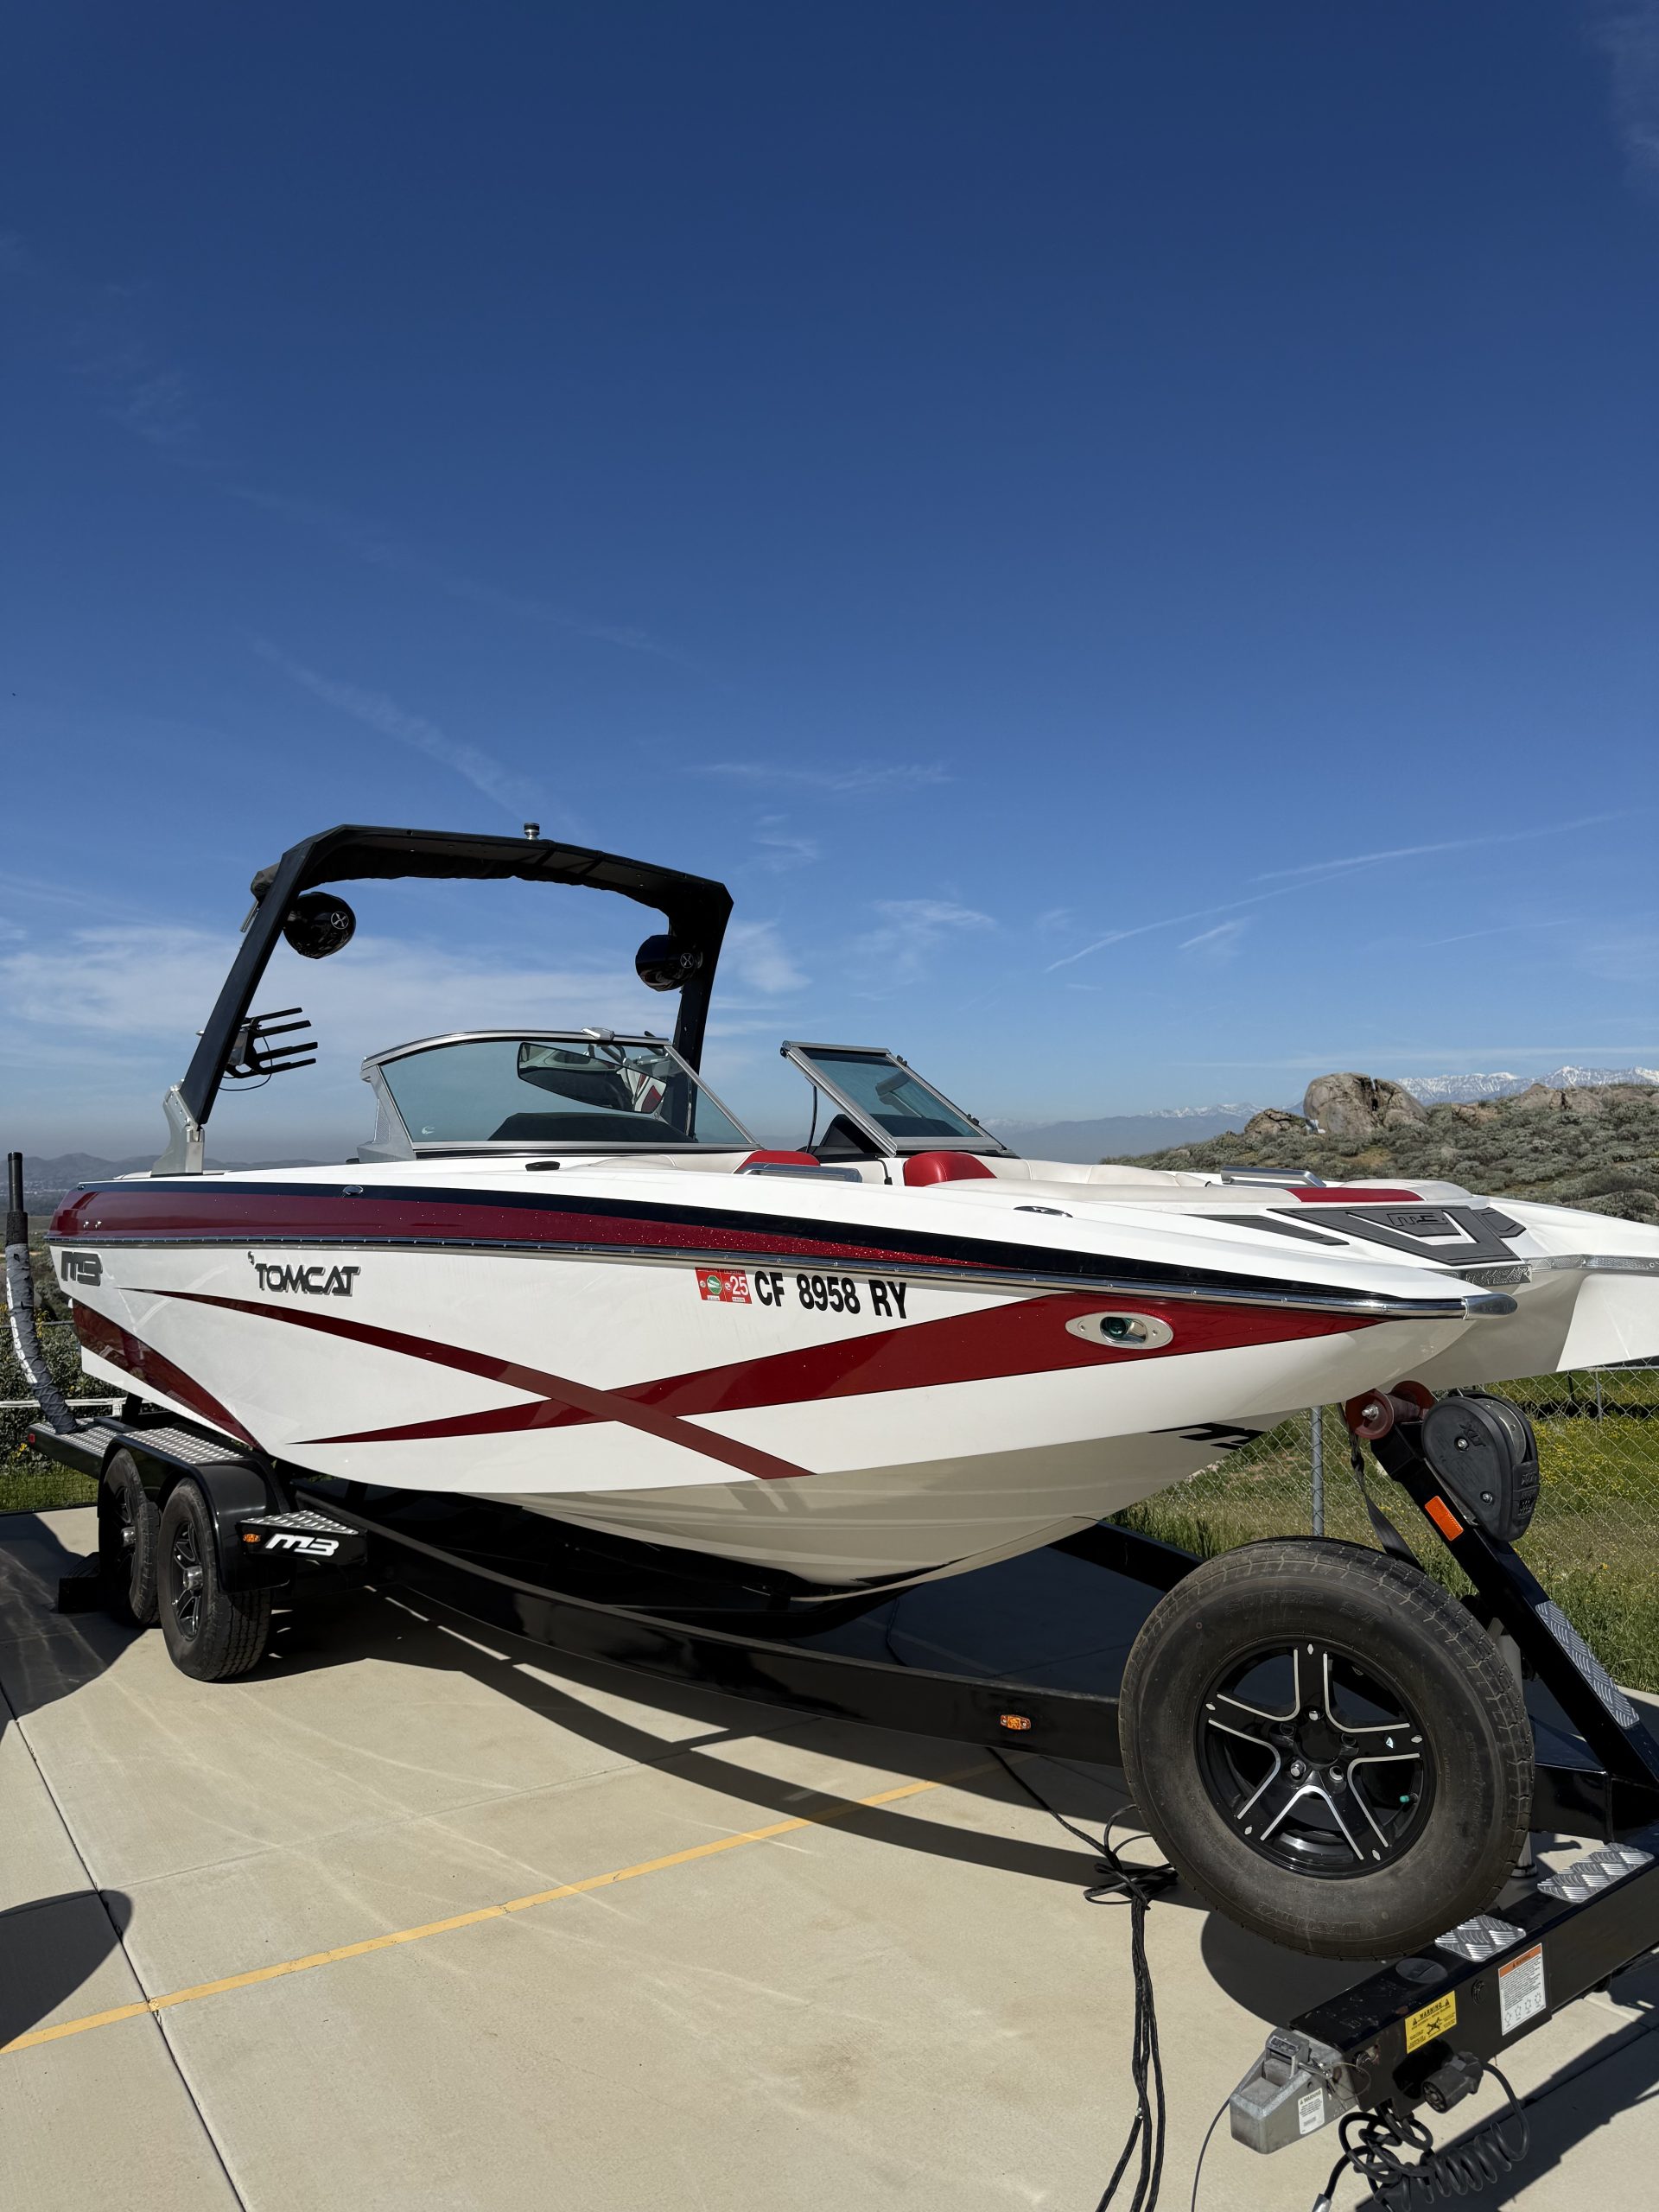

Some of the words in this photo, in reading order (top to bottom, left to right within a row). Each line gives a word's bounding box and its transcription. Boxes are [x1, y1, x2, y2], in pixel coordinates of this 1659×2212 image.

[254, 1262, 361, 1297] TOMCAT
[729, 1275, 749, 1296] 25
[754, 1270, 785, 1307] CF
[796, 1273, 861, 1314] 8958
[868, 1279, 907, 1319] RY
[1420, 2002, 1442, 2018] WARNING
